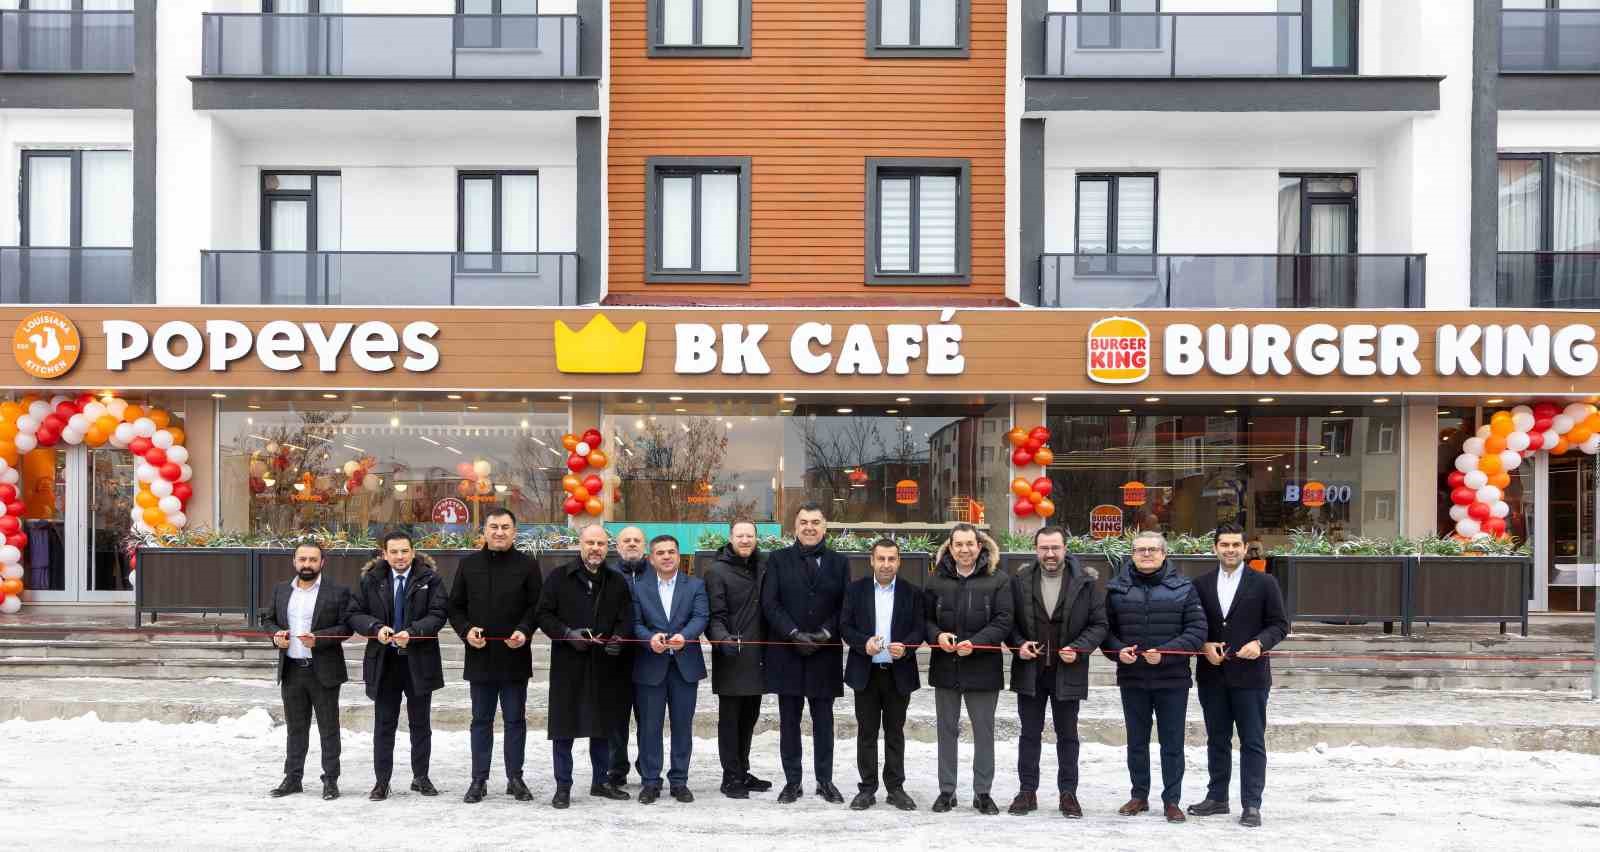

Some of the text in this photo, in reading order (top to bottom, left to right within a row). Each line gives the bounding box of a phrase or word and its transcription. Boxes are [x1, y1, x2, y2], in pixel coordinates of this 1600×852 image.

[24, 316, 70, 333] LOUISIANA
[674, 309, 966, 375] BK CAFÉ
[1091, 338, 1146, 350] BURGER
[1163, 324, 1598, 376] BURGER KING
[25, 360, 67, 373] KITCHEN
[1091, 351, 1146, 369] KING
[1092, 522, 1121, 531] KING
